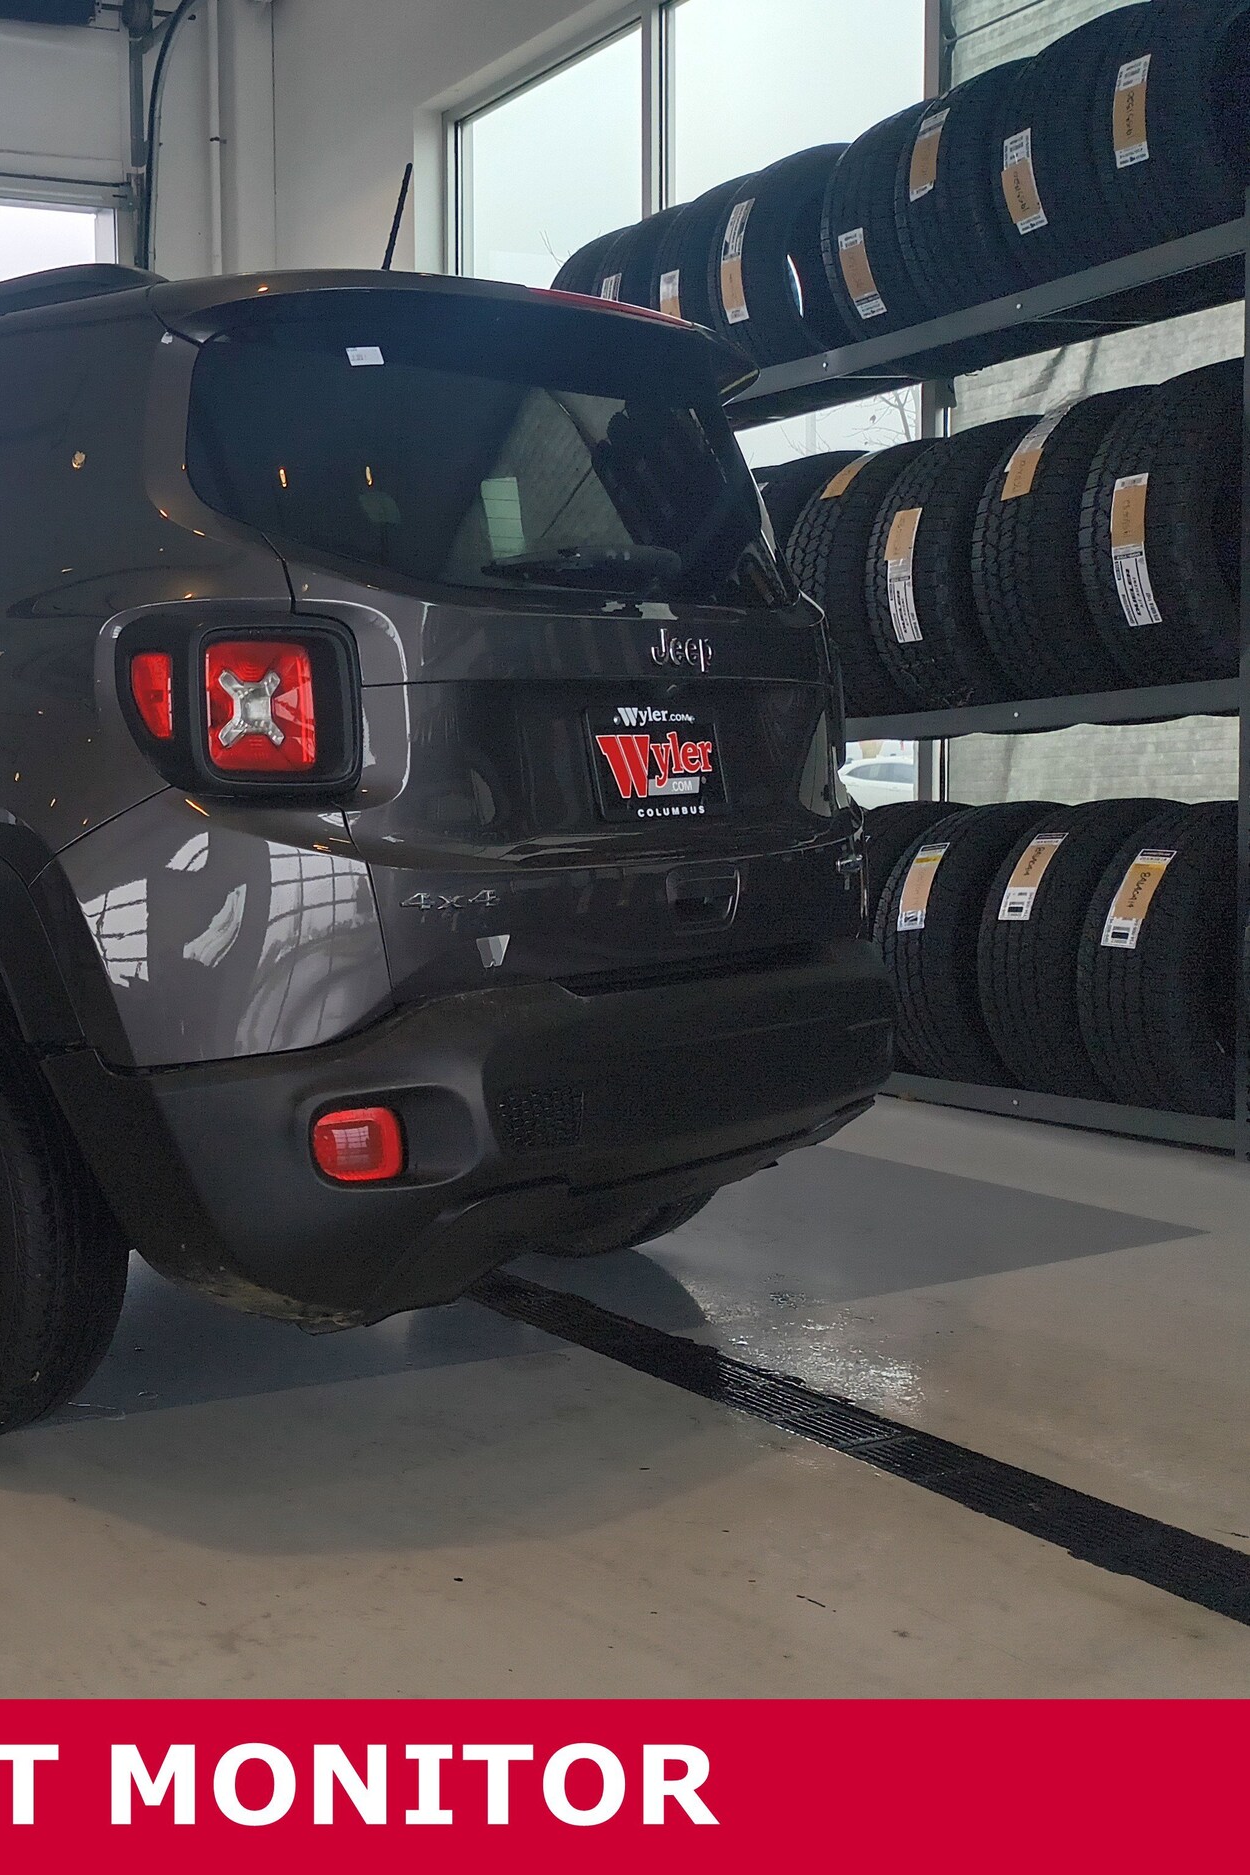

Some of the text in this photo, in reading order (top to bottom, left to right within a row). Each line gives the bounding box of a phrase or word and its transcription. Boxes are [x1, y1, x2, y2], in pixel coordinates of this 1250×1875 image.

[651, 628, 713, 673] Jeep
[595, 731, 713, 798] Wyler
[637, 805, 705, 818] COLUMBUS
